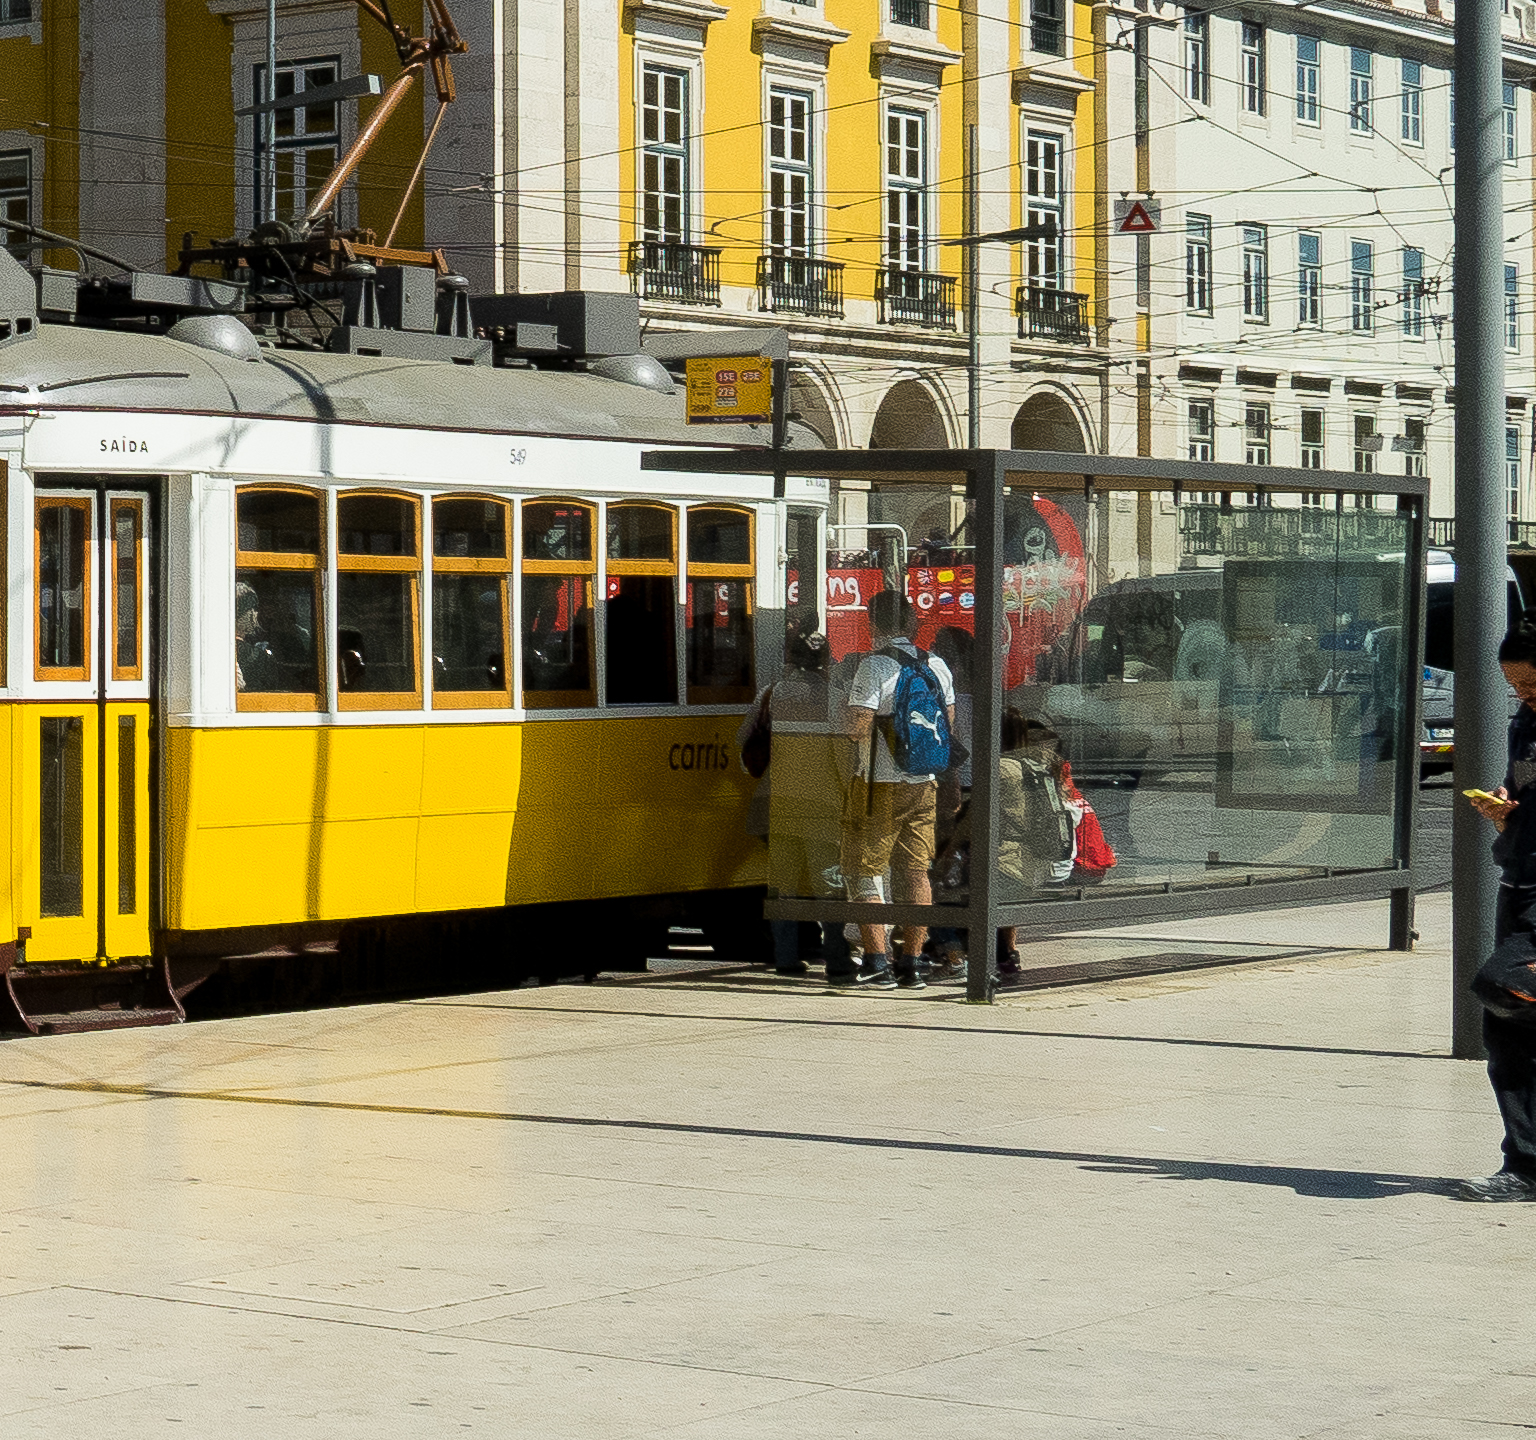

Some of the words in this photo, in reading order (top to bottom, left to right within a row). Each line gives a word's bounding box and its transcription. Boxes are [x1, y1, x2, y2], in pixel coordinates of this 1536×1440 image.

[100, 435, 148, 453] SAÍDA
[510, 448, 527, 465] 549
[669, 732, 728, 771] carris
